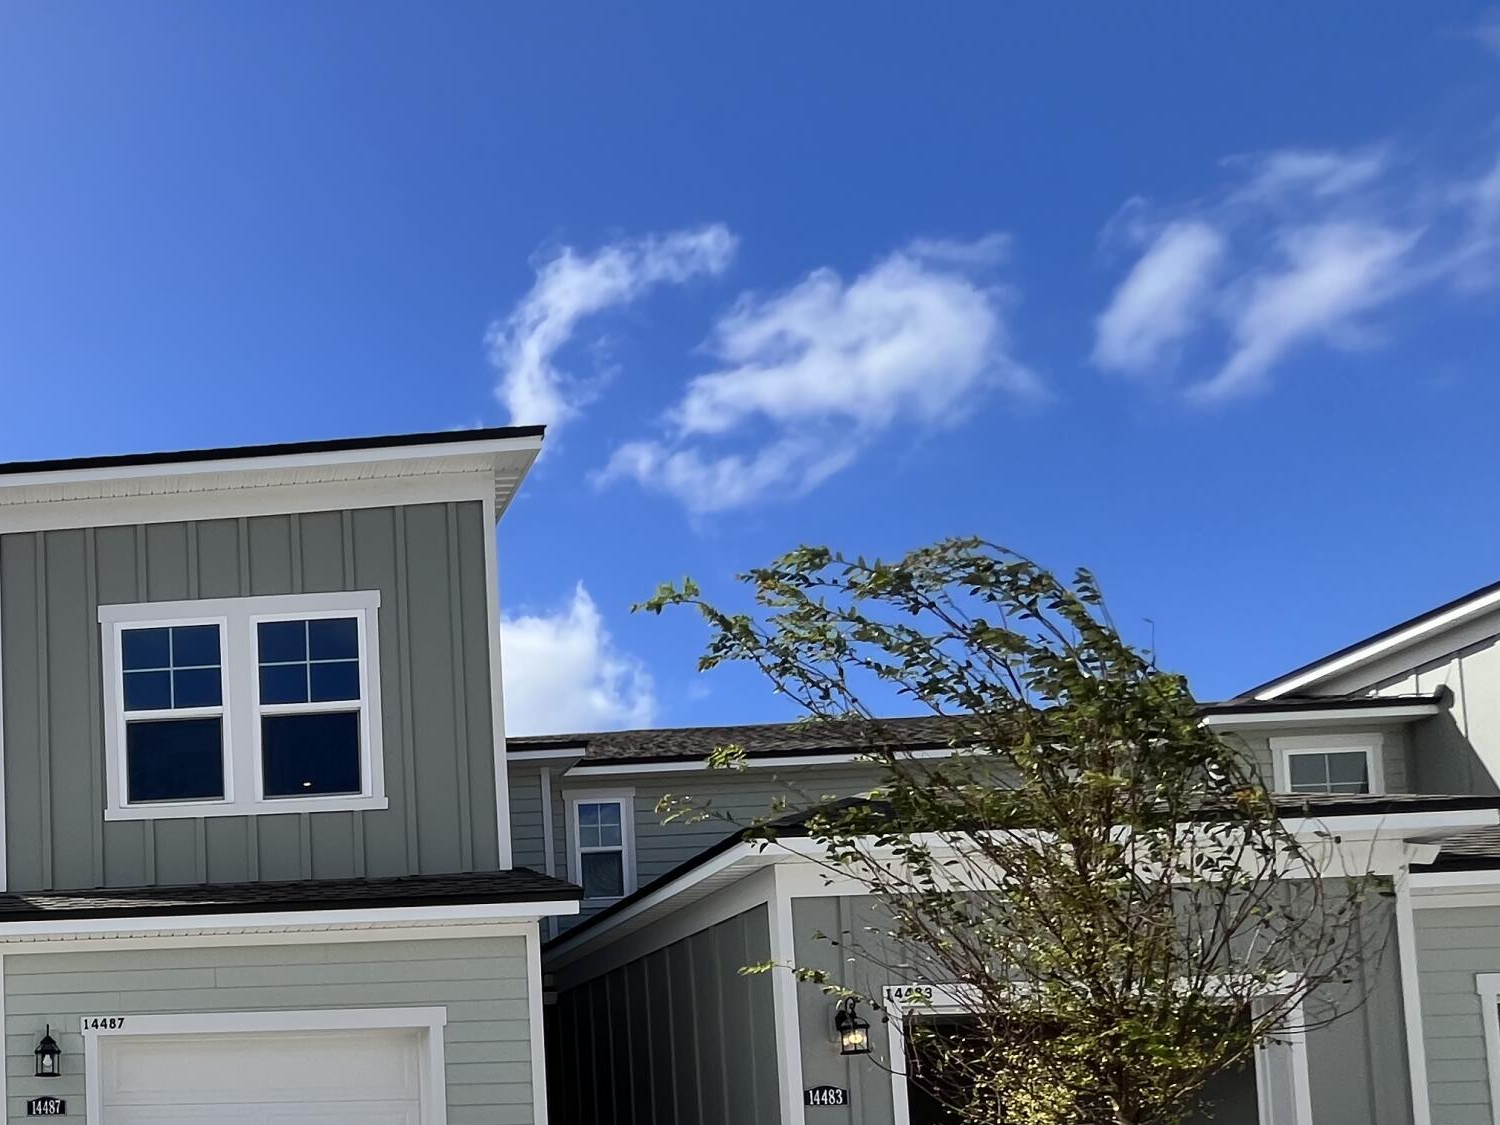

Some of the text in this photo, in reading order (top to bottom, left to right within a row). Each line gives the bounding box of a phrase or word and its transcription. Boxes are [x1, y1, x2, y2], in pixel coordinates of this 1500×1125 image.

[84, 1018, 125, 1030] 14487
[809, 1089, 843, 1104] 14483
[32, 1100, 60, 1115] 14487
